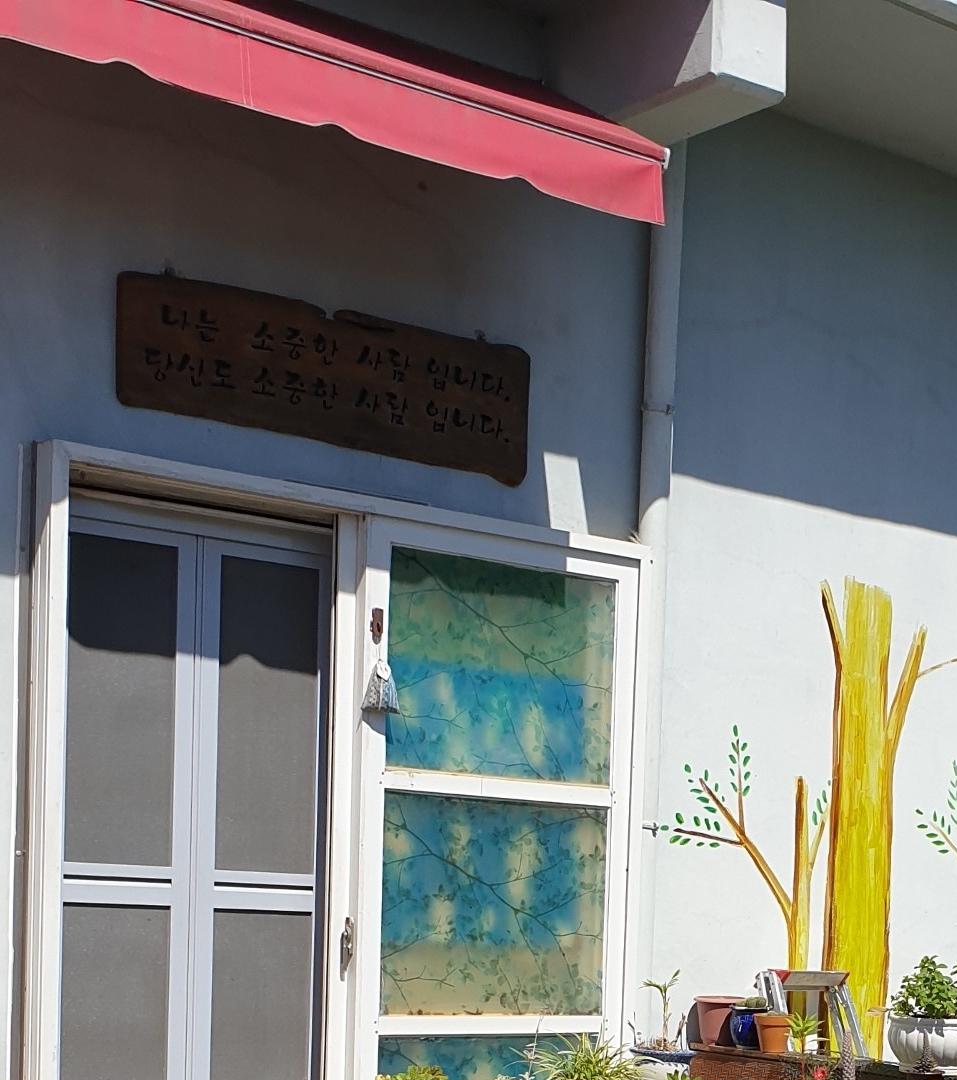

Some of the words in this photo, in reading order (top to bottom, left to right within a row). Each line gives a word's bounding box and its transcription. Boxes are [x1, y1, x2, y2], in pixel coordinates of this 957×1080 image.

[144, 347, 237, 391] 당신도
[251, 367, 338, 411] 소중한
[354, 386, 410, 426] 사람
[426, 399, 510, 443] 입니다.
[160, 304, 220, 343] 나는
[250, 321, 339, 367] 소중한
[355, 344, 411, 384] 사람
[426, 357, 511, 402] 입니다.
